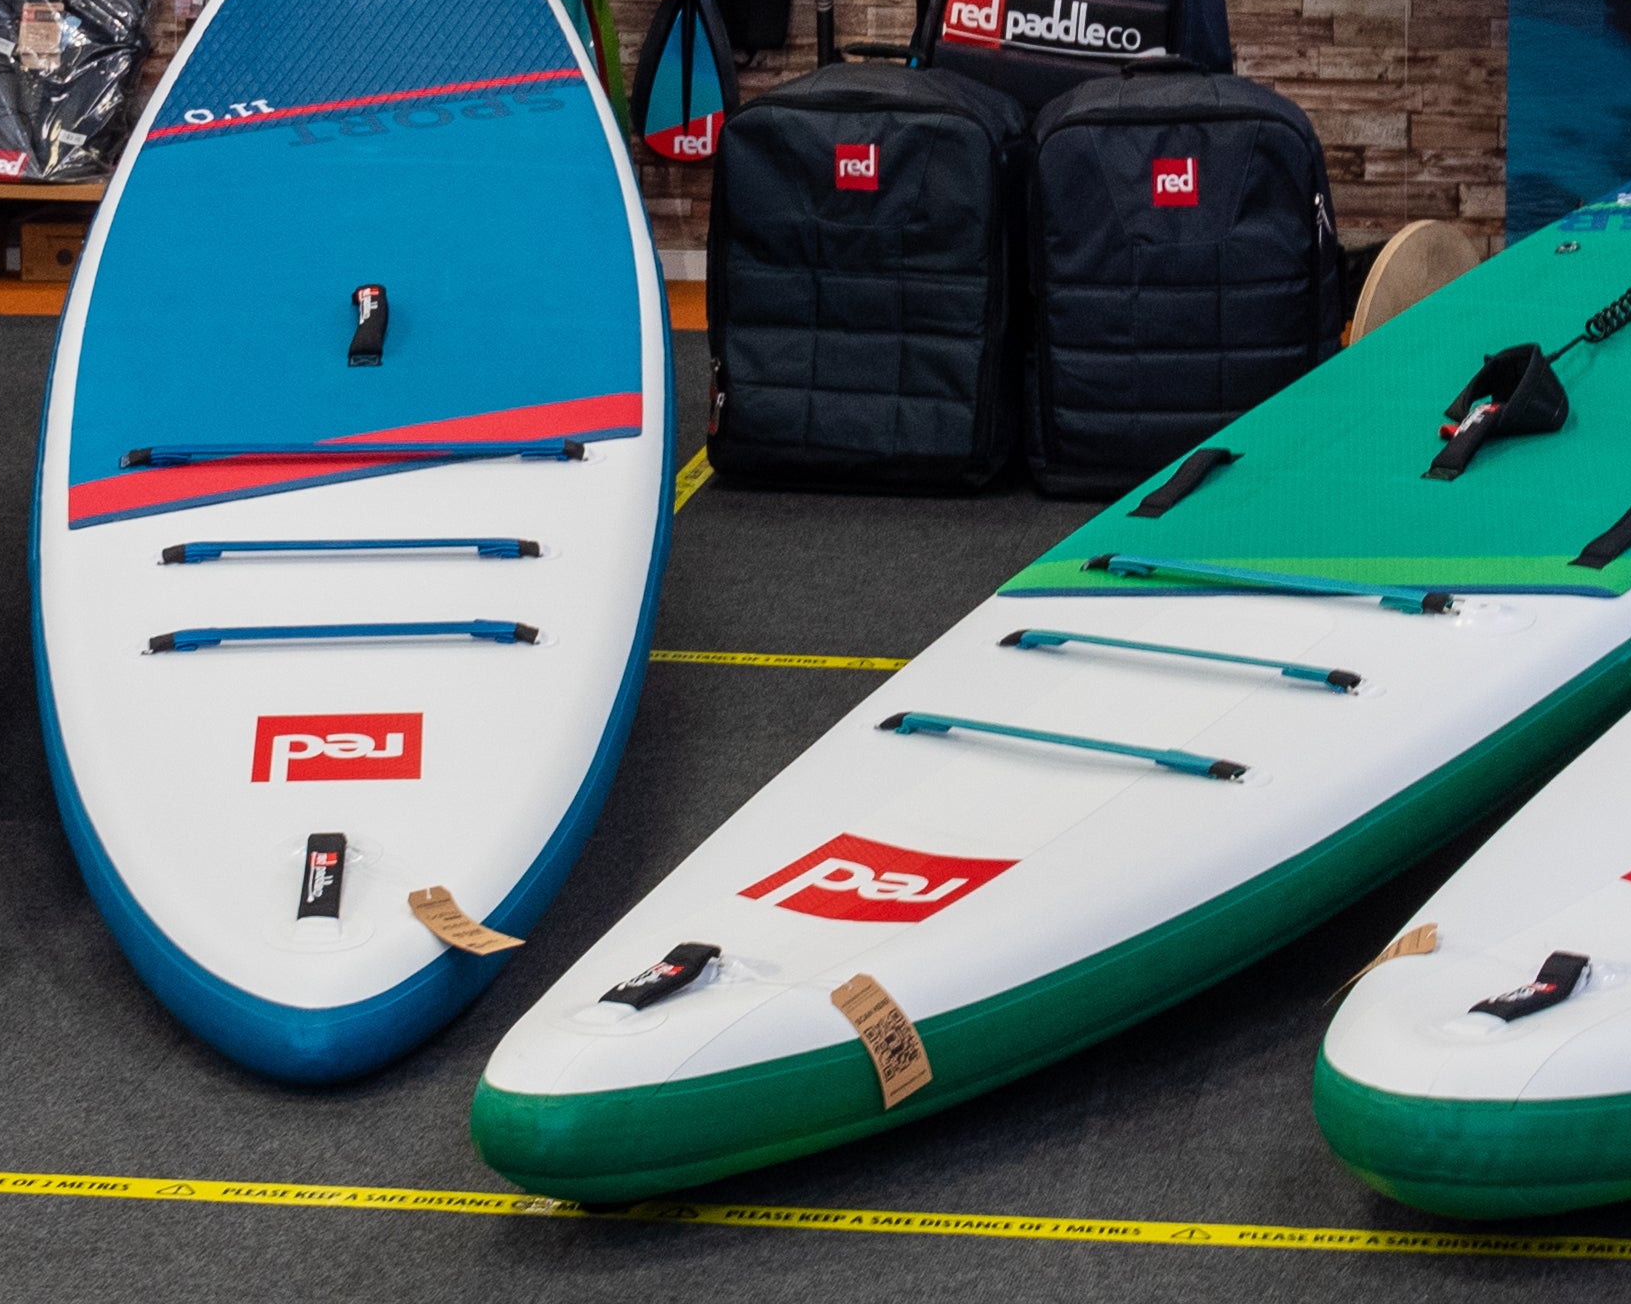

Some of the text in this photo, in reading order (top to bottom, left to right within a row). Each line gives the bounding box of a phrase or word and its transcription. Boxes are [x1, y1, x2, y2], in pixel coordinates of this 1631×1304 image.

[184, 98, 276, 126] 11'0
[290, 92, 566, 146] SPORT
[673, 114, 716, 155] red
[838, 144, 876, 177] red
[1156, 158, 1194, 193] red
[268, 731, 405, 783] red
[756, 856, 970, 905] red
[10, 1178, 40, 1189] OF
[45, 1179, 58, 1189] 2
[58, 1180, 131, 1192] METRES
[222, 1186, 288, 1200] PLEASE
[294, 1190, 343, 1202] KEEP
[346, 1192, 359, 1203] A
[363, 1193, 408, 1205] SAFE
[412, 1195, 508, 1209] DISTANCE
[724, 1209, 1143, 1236] PLEASE KEEP A SAFE DISTANCE OF 2 METRES
[1238, 1230, 1307, 1242] PLEASE
[1312, 1233, 1362, 1244] KEEP
[1384, 1235, 1428, 1247] SAFE
[1435, 1237, 1534, 1250] DISTANCE
[1537, 1241, 1568, 1252] OF
